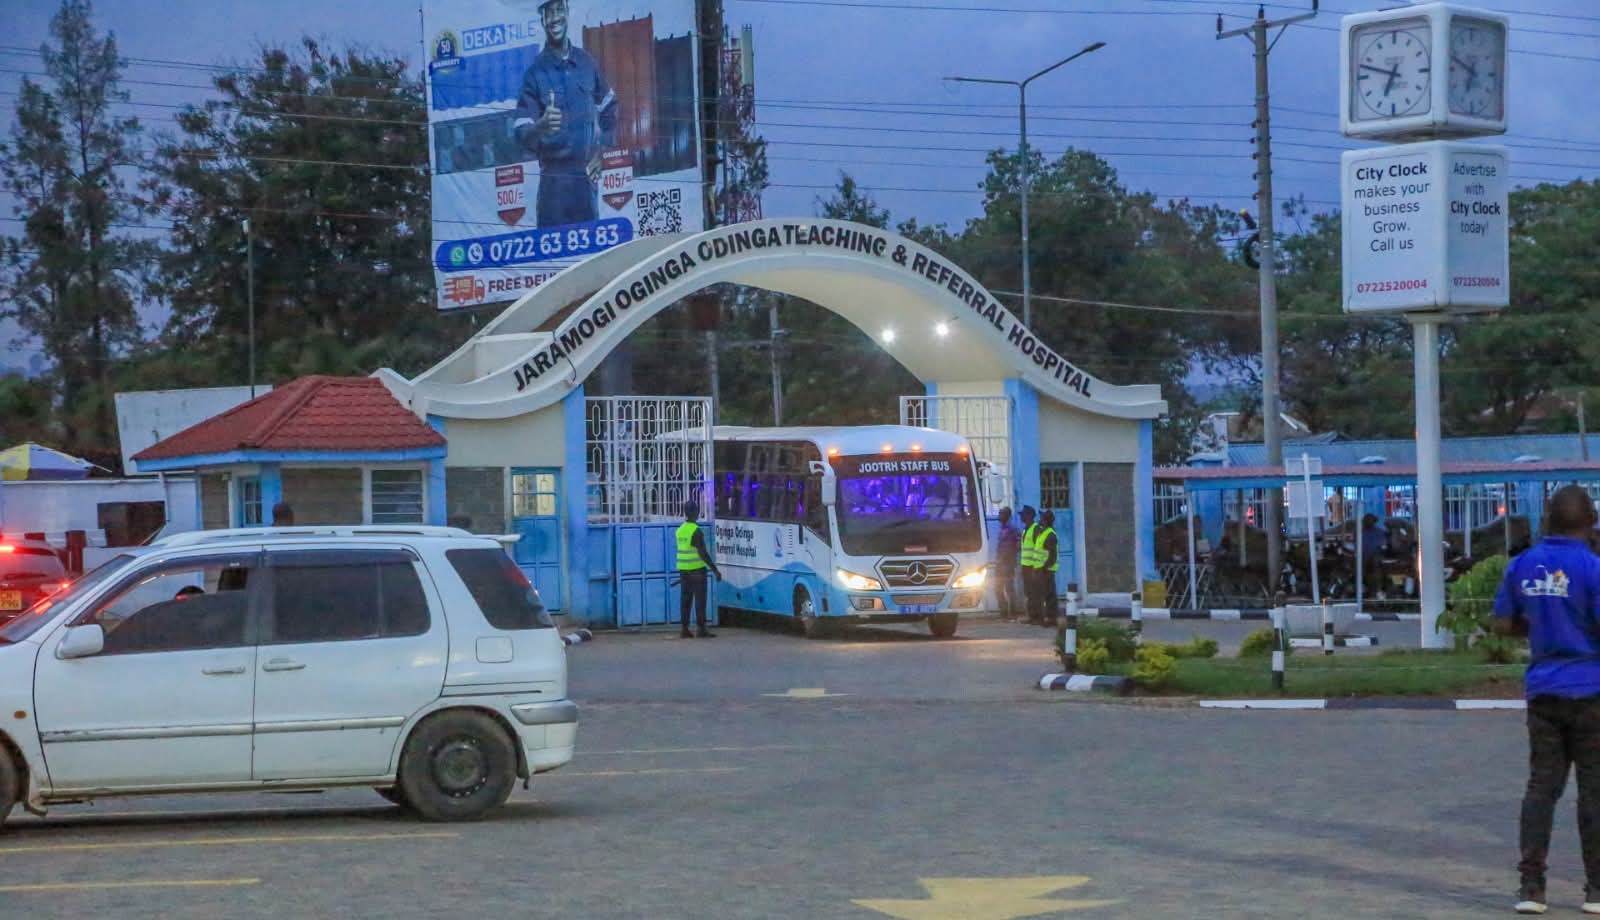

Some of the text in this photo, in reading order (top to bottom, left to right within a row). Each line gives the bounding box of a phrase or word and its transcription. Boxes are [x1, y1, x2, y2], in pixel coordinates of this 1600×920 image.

[440, 39, 451, 53] 50
[1356, 162, 1428, 182] City Clock
[1453, 163, 1497, 177] Advertise
[1354, 183, 1431, 200] makes your
[1464, 183, 1485, 196] with
[1364, 202, 1420, 217] business
[1450, 200, 1501, 217] City Clock
[1373, 220, 1411, 234] Grow.
[1460, 220, 1489, 237] today!
[490, 223, 619, 262] 0722 63 83 83
[1370, 238, 1415, 252] Call us
[488, 276, 522, 293] FREE
[1356, 279, 1428, 293] 0722520004
[1453, 276, 1501, 288] 0722520004
[513, 224, 1092, 398] JARAMOGI OGINGA ODINGA TEACHING & REFERRAL HOSPITAL
[859, 460, 950, 473] JOOTRH STAFF BUS
